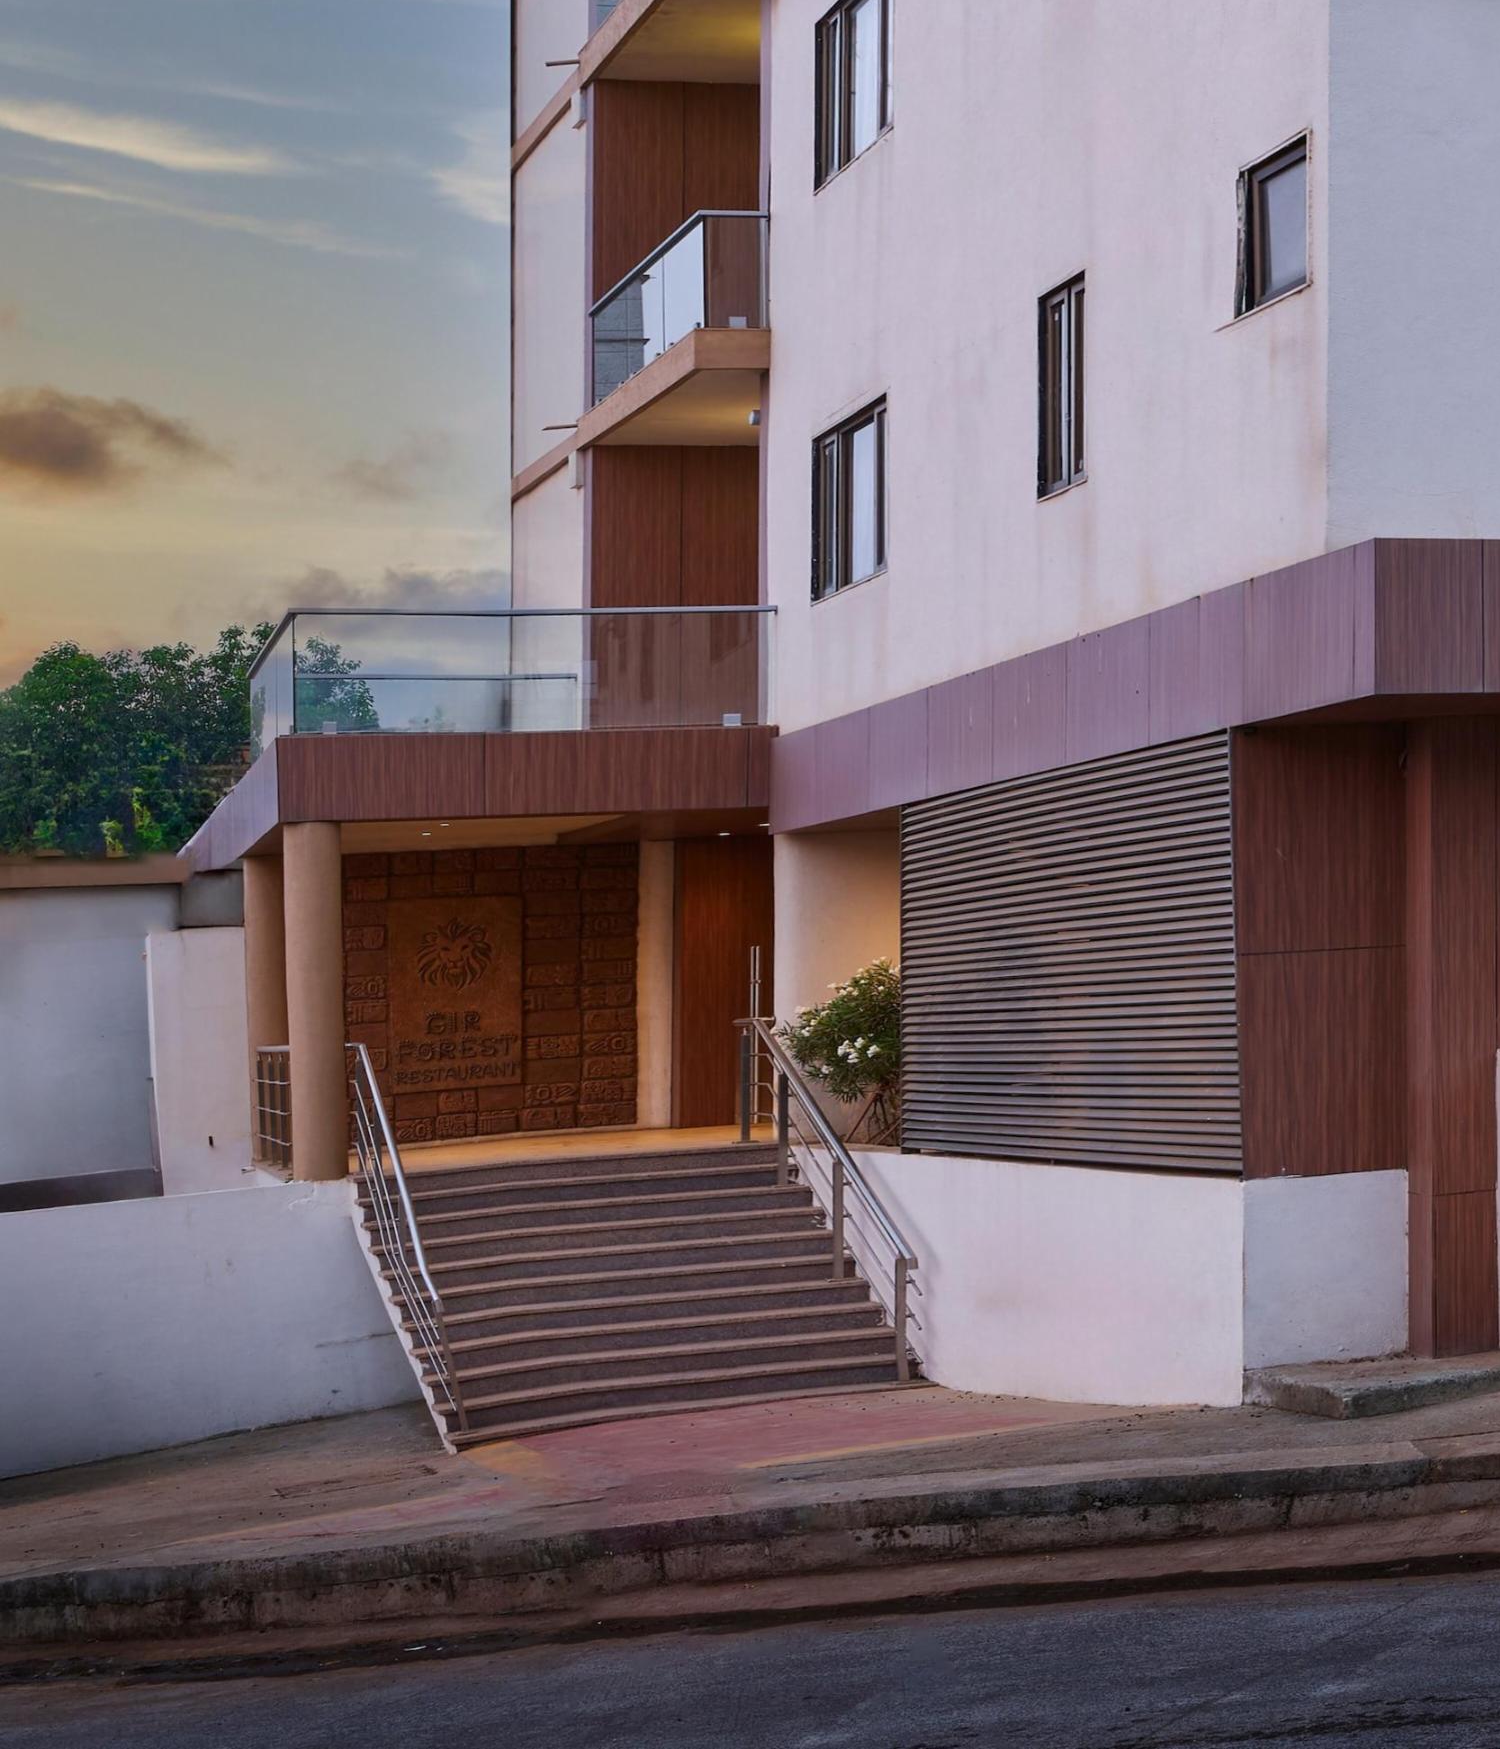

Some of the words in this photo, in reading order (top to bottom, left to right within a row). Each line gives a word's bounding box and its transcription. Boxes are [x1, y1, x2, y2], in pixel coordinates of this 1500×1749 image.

[425, 1011, 481, 1035] GIR
[398, 1034, 518, 1064] FOREST
[393, 1061, 520, 1085] RESTAURANT
